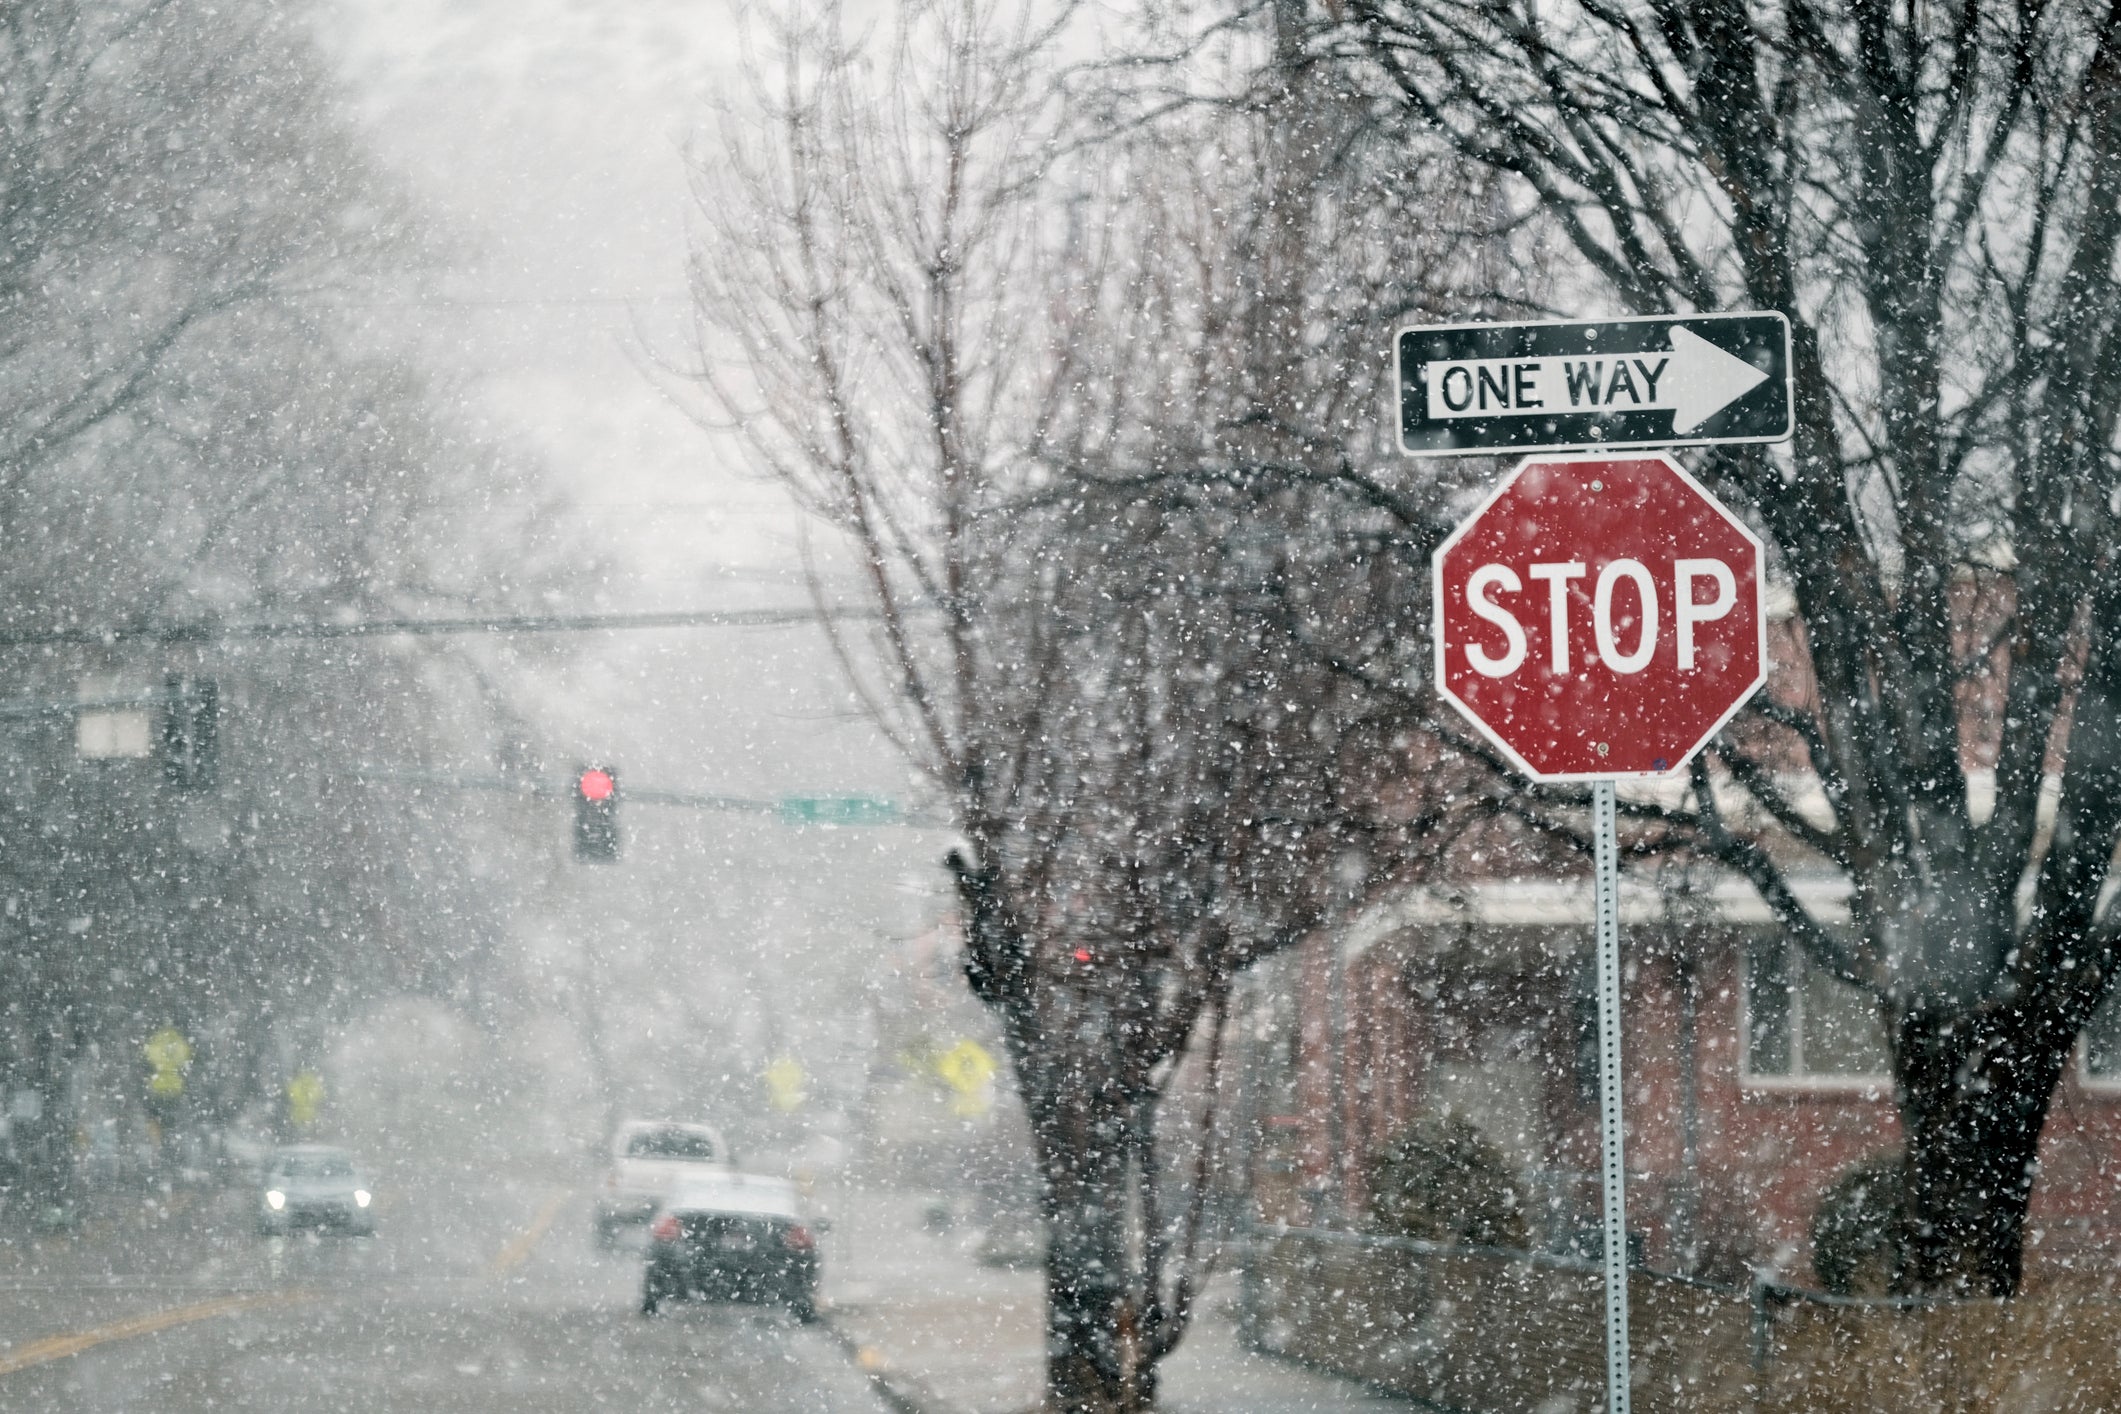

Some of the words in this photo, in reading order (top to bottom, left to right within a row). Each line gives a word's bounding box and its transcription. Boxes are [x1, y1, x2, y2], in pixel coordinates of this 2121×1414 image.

[1442, 364, 1542, 411] ONE
[1564, 358, 1669, 407] WAY
[1464, 558, 1737, 678] STOP
